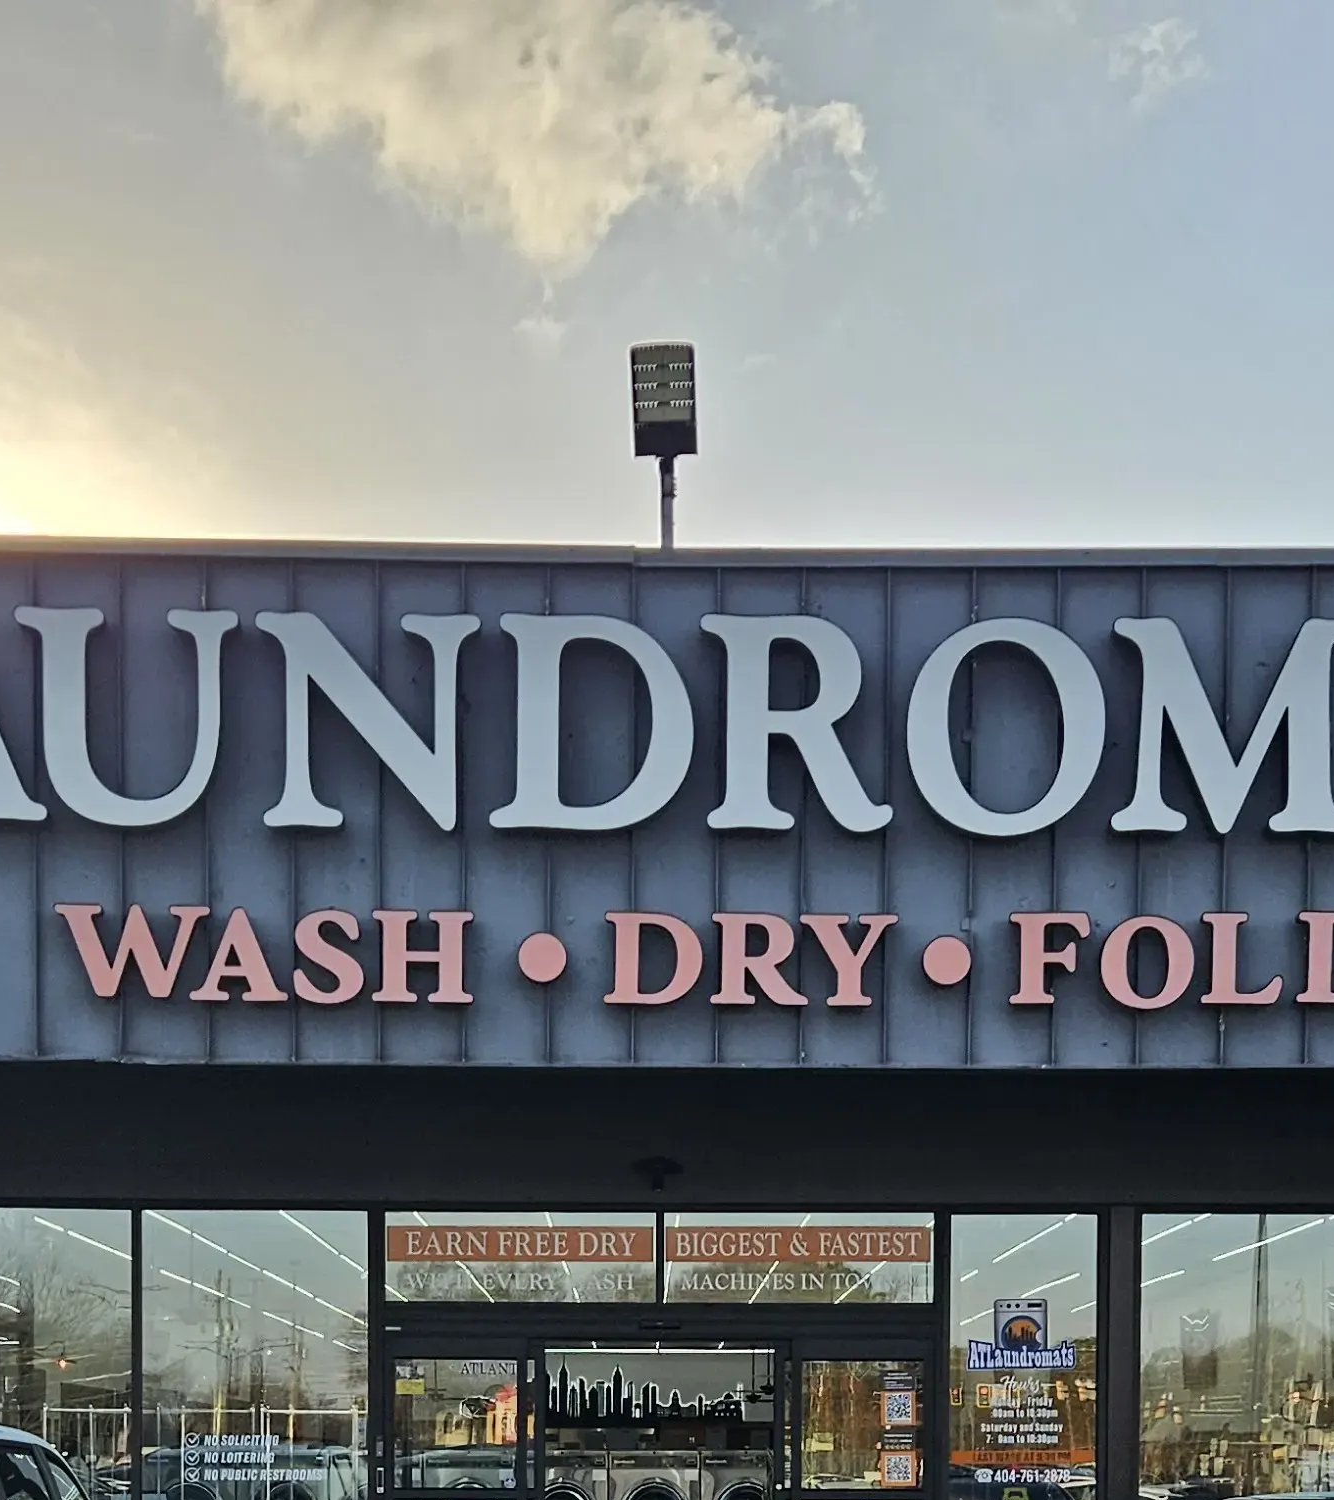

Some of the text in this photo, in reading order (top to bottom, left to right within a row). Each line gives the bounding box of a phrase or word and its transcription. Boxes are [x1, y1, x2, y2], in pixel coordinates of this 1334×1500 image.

[53, 902, 475, 1004] WASH
[602, 910, 899, 1006] DRY
[406, 1231, 636, 1257] EARN FREE DRY
[676, 1232, 922, 1257] BIGGEST & FASTEST
[575, 1274, 635, 1290] ASH
[681, 1273, 795, 1291] MACHINES
[801, 1273, 825, 1290] IN
[969, 1341, 1075, 1369] ATLaundromats
[1000, 1376, 1041, 1394] Hours
[1027, 1397, 1054, 1410] Friday
[1016, 1408, 1025, 1418] to
[980, 1422, 1064, 1434] Saturday and Sunday
[204, 1434, 280, 1447] NO SOLICITING
[1016, 1433, 1025, 1443] to
[204, 1451, 275, 1464] NO LOITERING
[204, 1468, 324, 1481] NO PUBLIC RESTROOMS
[993, 1468, 1071, 1483] 404-761-2878
